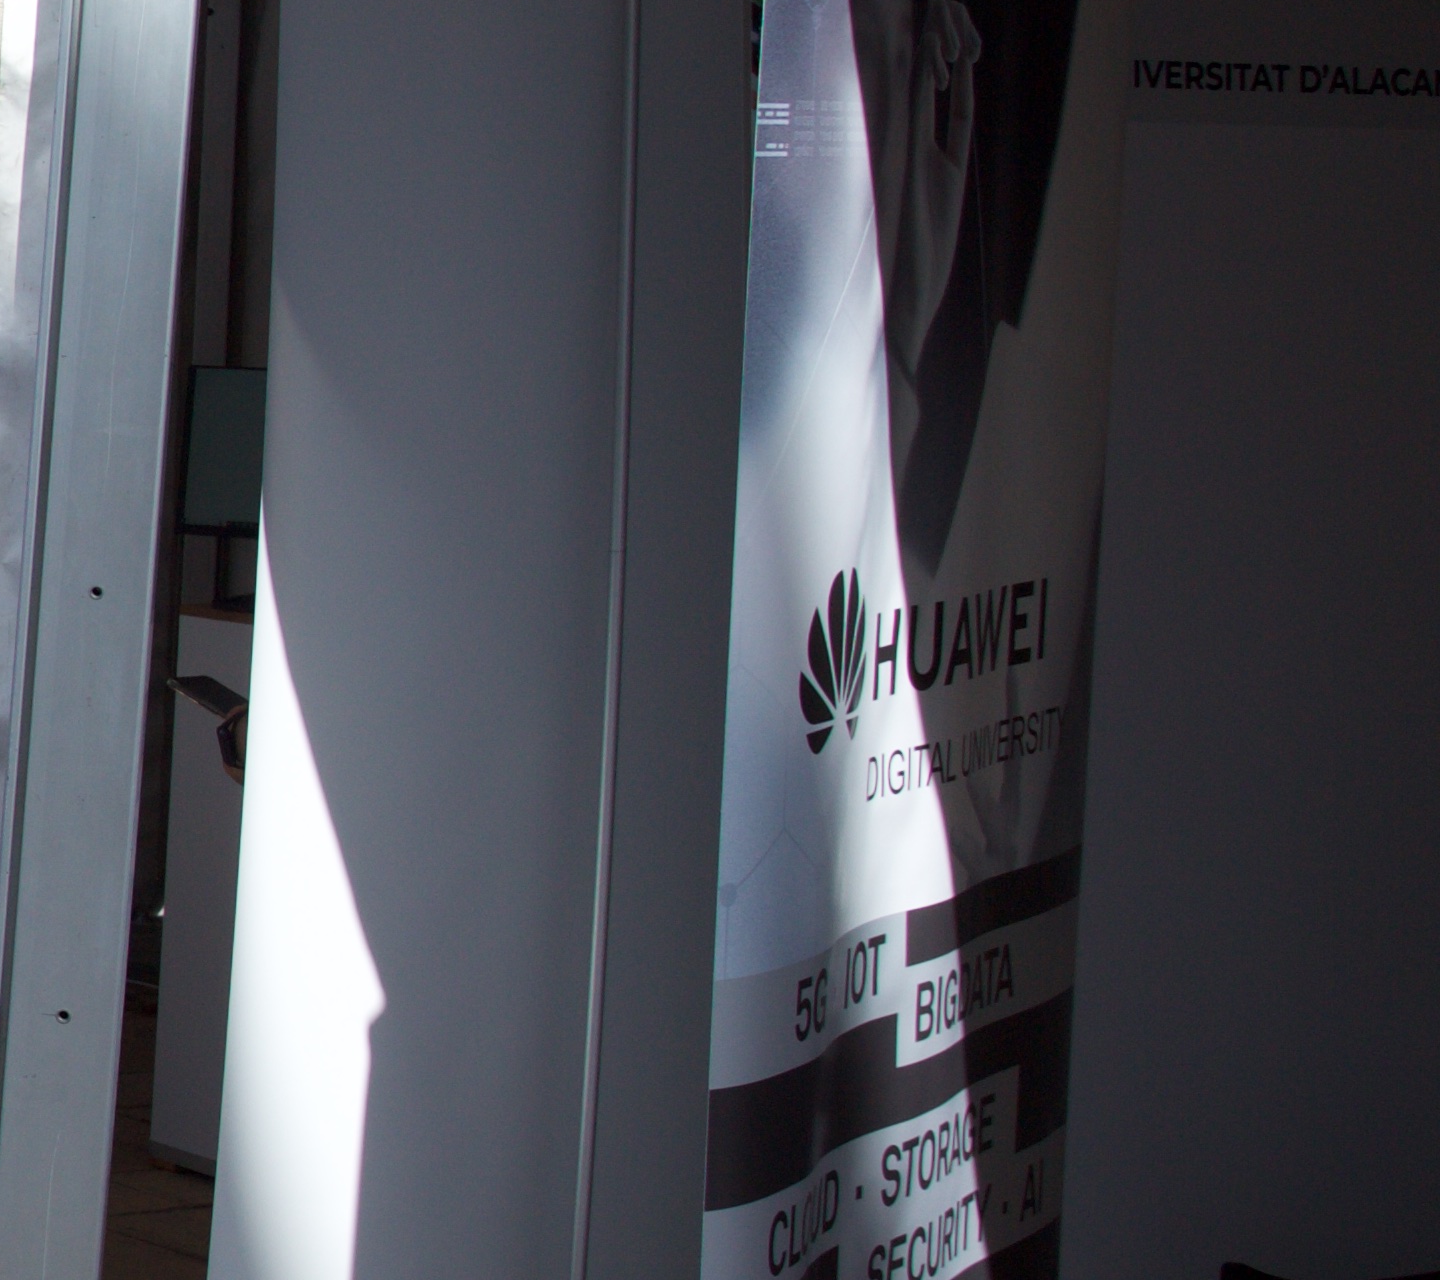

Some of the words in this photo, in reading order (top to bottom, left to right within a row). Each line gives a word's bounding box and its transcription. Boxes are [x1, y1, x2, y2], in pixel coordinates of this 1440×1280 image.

[1134, 59, 1289, 93] IVERSITAT
[873, 577, 1049, 701] HUAWEI
[866, 741, 957, 801] DIGITAL
[961, 704, 1067, 777] UNIVERSITY
[796, 968, 828, 1042] 5G
[844, 934, 886, 1009] IOT
[769, 1171, 840, 1277] CLOUD
[881, 1092, 996, 1207] STORAGE
[1021, 1159, 1044, 1222] AI
